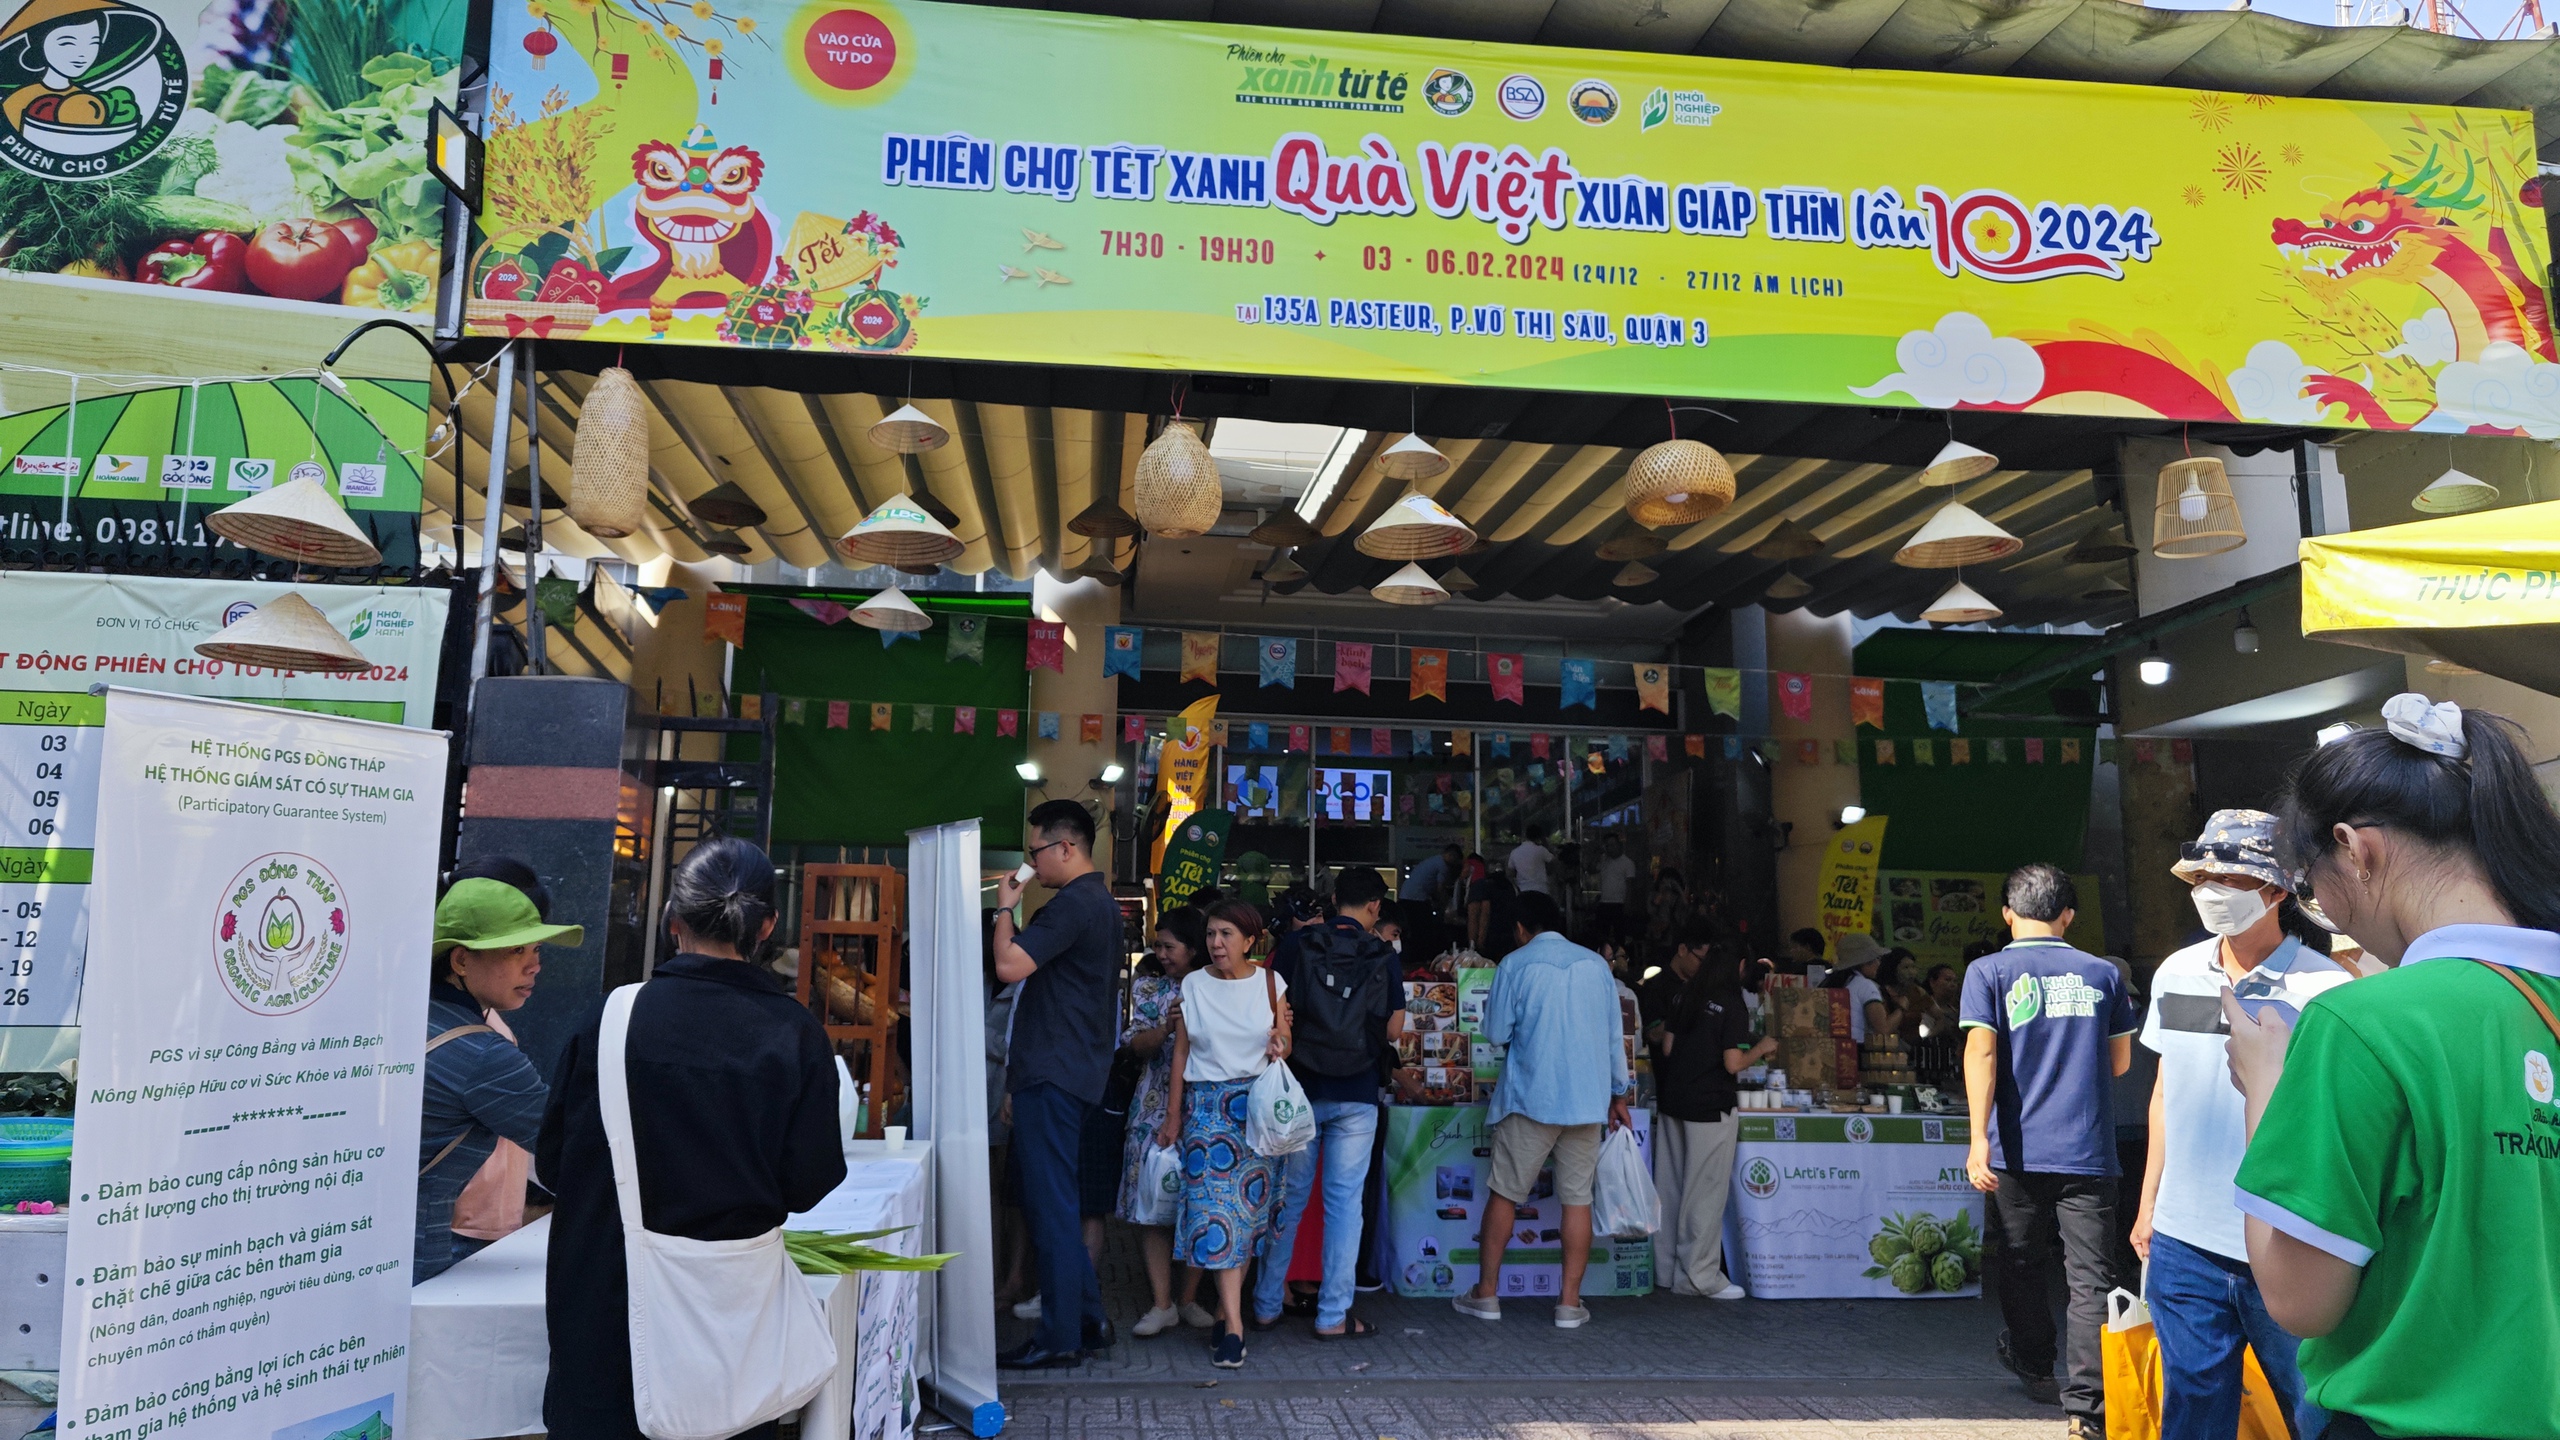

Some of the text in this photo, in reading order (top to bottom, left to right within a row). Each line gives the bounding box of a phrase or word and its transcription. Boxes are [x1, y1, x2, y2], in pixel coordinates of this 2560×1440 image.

[818, 32, 883, 48] VÀO CỬA
[827, 50, 873, 65] TỰ DO
[1226, 43, 1262, 63] Phiên
[1240, 95, 1256, 103] THE
[1262, 97, 1293, 105] GREEN
[1321, 101, 1345, 109] SAFE
[1350, 103, 1374, 111] FOOD
[2, 135, 55, 170] PHIÊN
[62, 156, 107, 174] CHỢ
[115, 125, 164, 164] XANH
[163, 77, 183, 96] TẾ
[1675, 115, 1710, 125] XANH
[886, 135, 990, 186] PHIÊN
[1004, 145, 1078, 196] CHỢ
[1169, 155, 1265, 202] XANH
[1274, 140, 1407, 217] Quà
[1424, 145, 1574, 235] Việt
[1577, 179, 1665, 228] XUÂN
[1856, 192, 1927, 241] lần
[1922, 190, 2034, 275] 10
[2037, 206, 2154, 255] 2024
[798, 233, 845, 275] Tết
[1100, 230, 1164, 259] 7H30
[1199, 236, 1275, 265] 19H30
[1363, 245, 1391, 271] 03
[1426, 249, 1564, 281] 06.02.2024
[1687, 270, 1741, 291] 27/12
[498, 271, 518, 283] 2024
[862, 316, 883, 325] 2024
[1237, 305, 1257, 321] TẠI
[1264, 297, 1317, 323] 135A
[1330, 300, 1441, 333] PASTEUR,
[1514, 310, 1552, 340] THỊ
[1625, 315, 1682, 345] QUẬN
[1693, 321, 1706, 344] 3
[345, 484, 377, 493] MANDALA
[2417, 569, 2511, 604] THỰC
[97, 617, 125, 628] ĐƠN
[129, 618, 141, 631] VỊ
[375, 628, 405, 637] XANH
[16, 652, 223, 679] ĐỘNG PHIÊN CHỢ
[17, 700, 71, 723] Ngày
[41, 735, 67, 751] 03
[191, 739, 385, 773] HỆ THỐNG PGS ĐỒNG THÁP
[36, 763, 62, 779] 04
[145, 763, 414, 801] HỆ THỐNG GIÁM SÁT CÓ SỰ THAM GIA
[1175, 785, 1192, 793] NAM
[33, 791, 59, 807] 05
[179, 795, 386, 825] (Participatory Guarantee System)
[28, 818, 54, 835] 06
[17, 902, 42, 918] 05
[14, 931, 37, 948] 12
[10, 959, 33, 977] 19
[223, 942, 342, 1007] ORGANIC AGRICULTURE
[3, 988, 30, 1006] 26
[2046, 1002, 2094, 1017] XANH
[150, 1034, 383, 1064] PGS vì sự Công Bằng và Minh Bạch
[98, 1146, 385, 1200] Đảm bảo cung cấp nông sản hữu cơ
[1829, 1167, 1860, 1180] Farm
[97, 1169, 363, 1226] chất lượng cho thị trường nội địa
